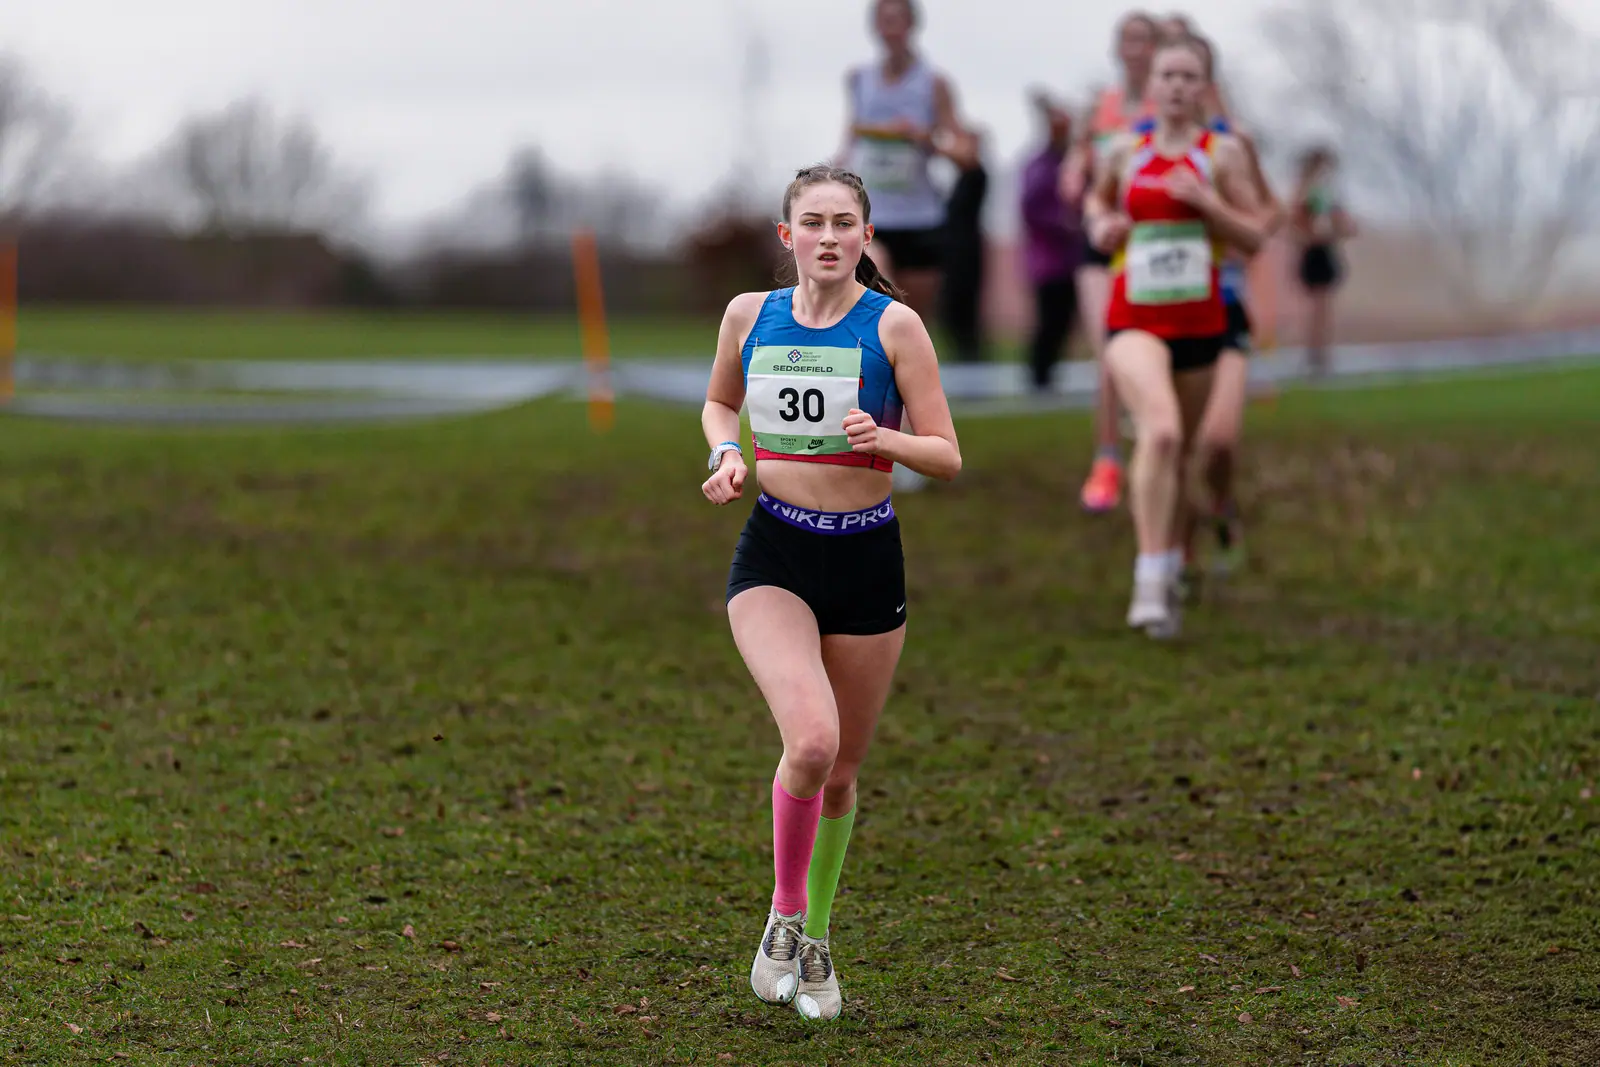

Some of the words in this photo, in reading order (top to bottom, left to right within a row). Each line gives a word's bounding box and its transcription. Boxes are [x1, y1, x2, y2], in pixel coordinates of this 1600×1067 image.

[773, 365, 833, 373] SEDGEFIELD
[778, 387, 825, 423] 30
[772, 503, 838, 530] NIKE
[841, 504, 890, 530] PRO
